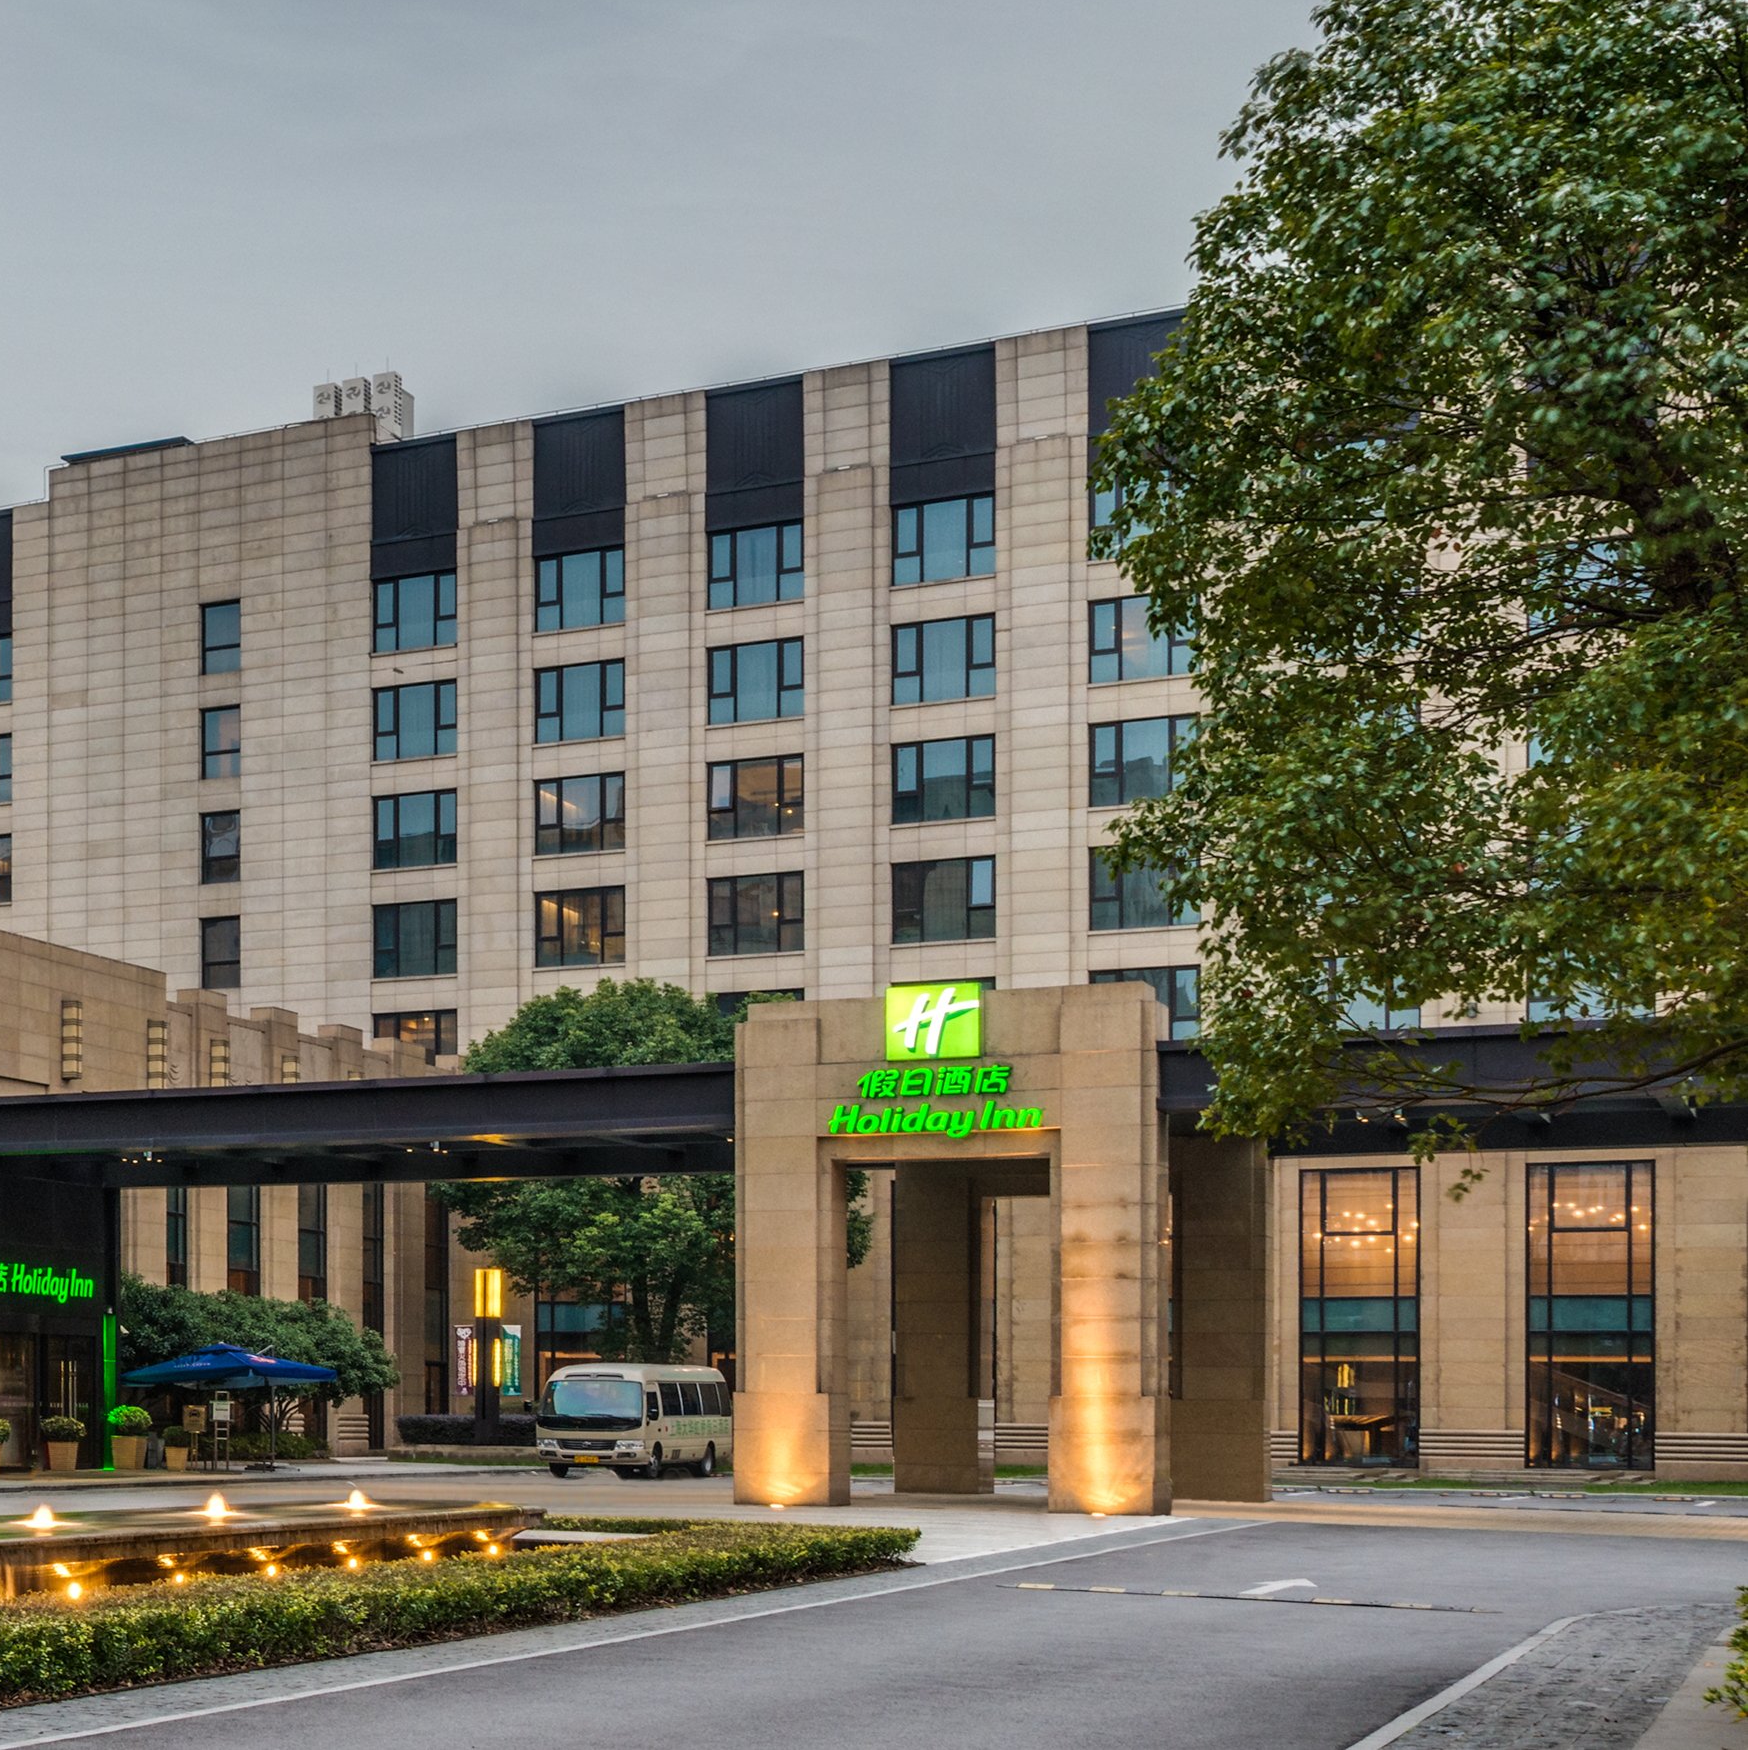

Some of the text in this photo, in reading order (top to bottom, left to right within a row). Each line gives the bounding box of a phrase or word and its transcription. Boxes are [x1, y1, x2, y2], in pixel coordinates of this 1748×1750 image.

[857, 1064, 1011, 1099] 假日酒店
[828, 1100, 1043, 1139] Holiday Inn
[11, 1263, 70, 1303] Holiday
[70, 1268, 94, 1298] Inn
